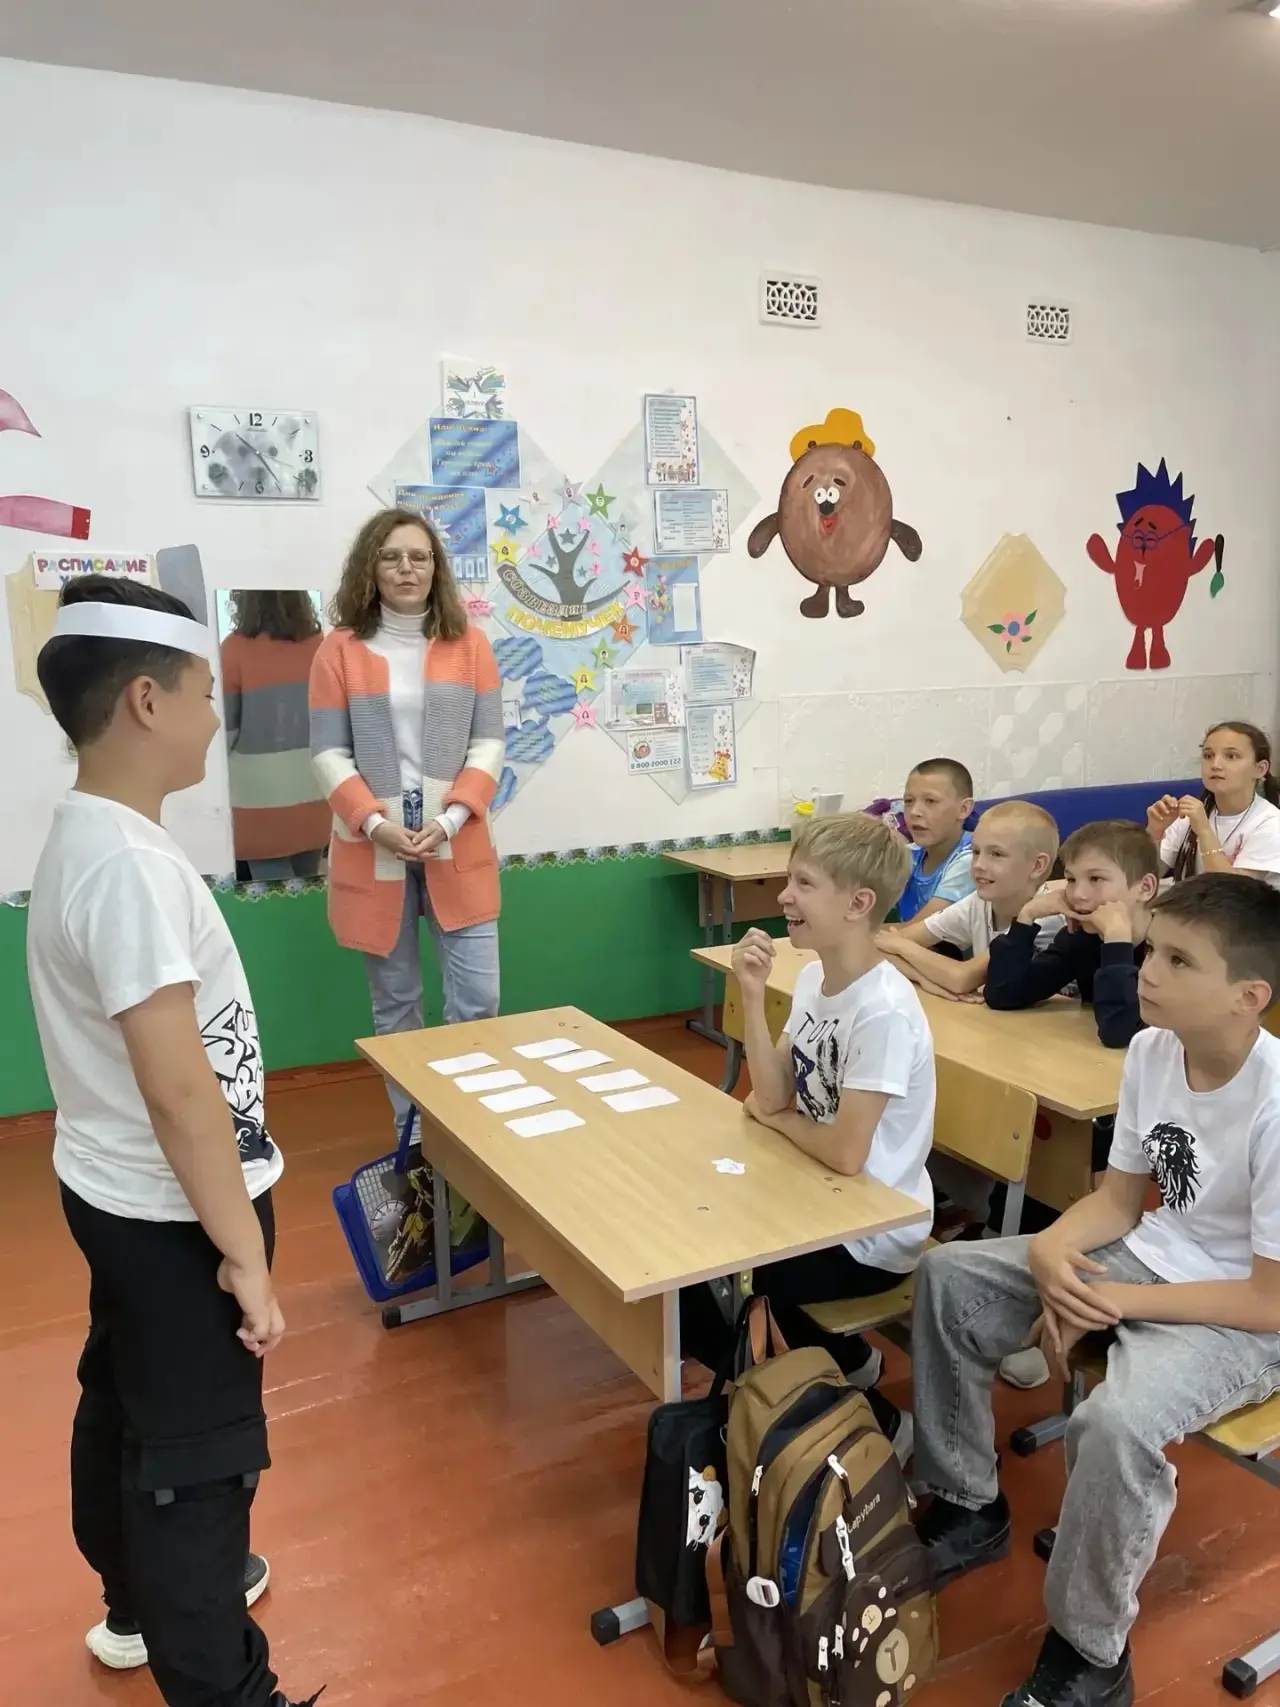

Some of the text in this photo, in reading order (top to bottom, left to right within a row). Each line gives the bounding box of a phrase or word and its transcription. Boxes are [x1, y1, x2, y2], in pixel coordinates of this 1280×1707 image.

[249, 413, 263, 427] 12
[200, 445, 210, 458] 9
[304, 449, 313, 463] 3
[254, 481, 264, 494] 6
[37, 558, 148, 573] РАСПИСАНИЕ
[502, 569, 588, 618] СОЗВЕЗДИЕ
[505, 601, 625, 638] ПОЧЕМУЧЕК
